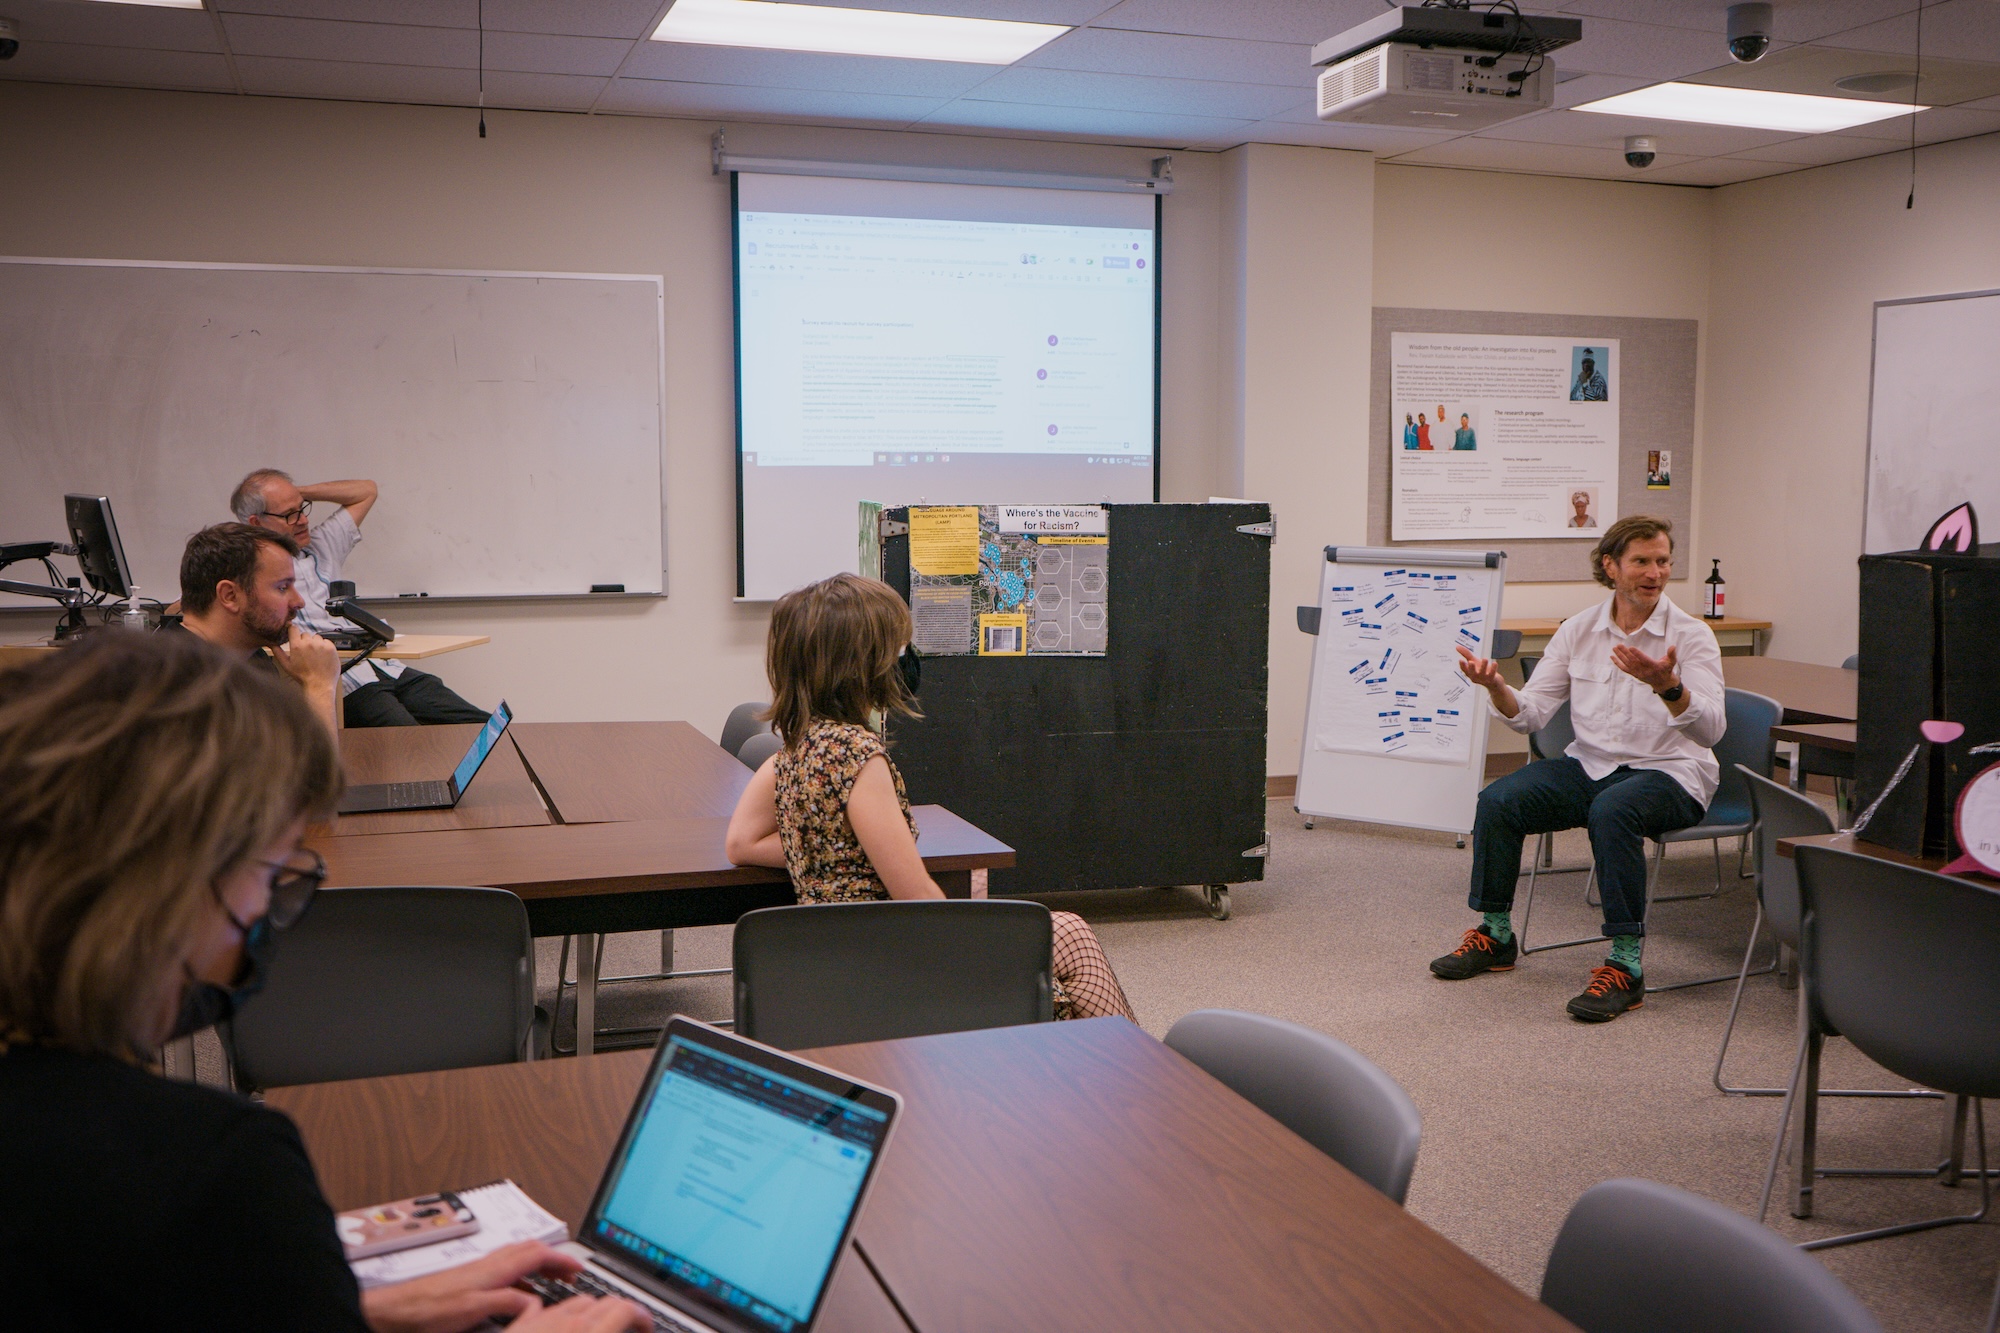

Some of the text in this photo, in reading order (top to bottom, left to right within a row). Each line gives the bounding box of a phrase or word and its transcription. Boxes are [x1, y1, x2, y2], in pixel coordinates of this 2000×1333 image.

[1006, 509, 1099, 518] Where's the Vaccine
[1024, 521, 1079, 530] for Racism?
[1980, 840, 1990, 851] in
